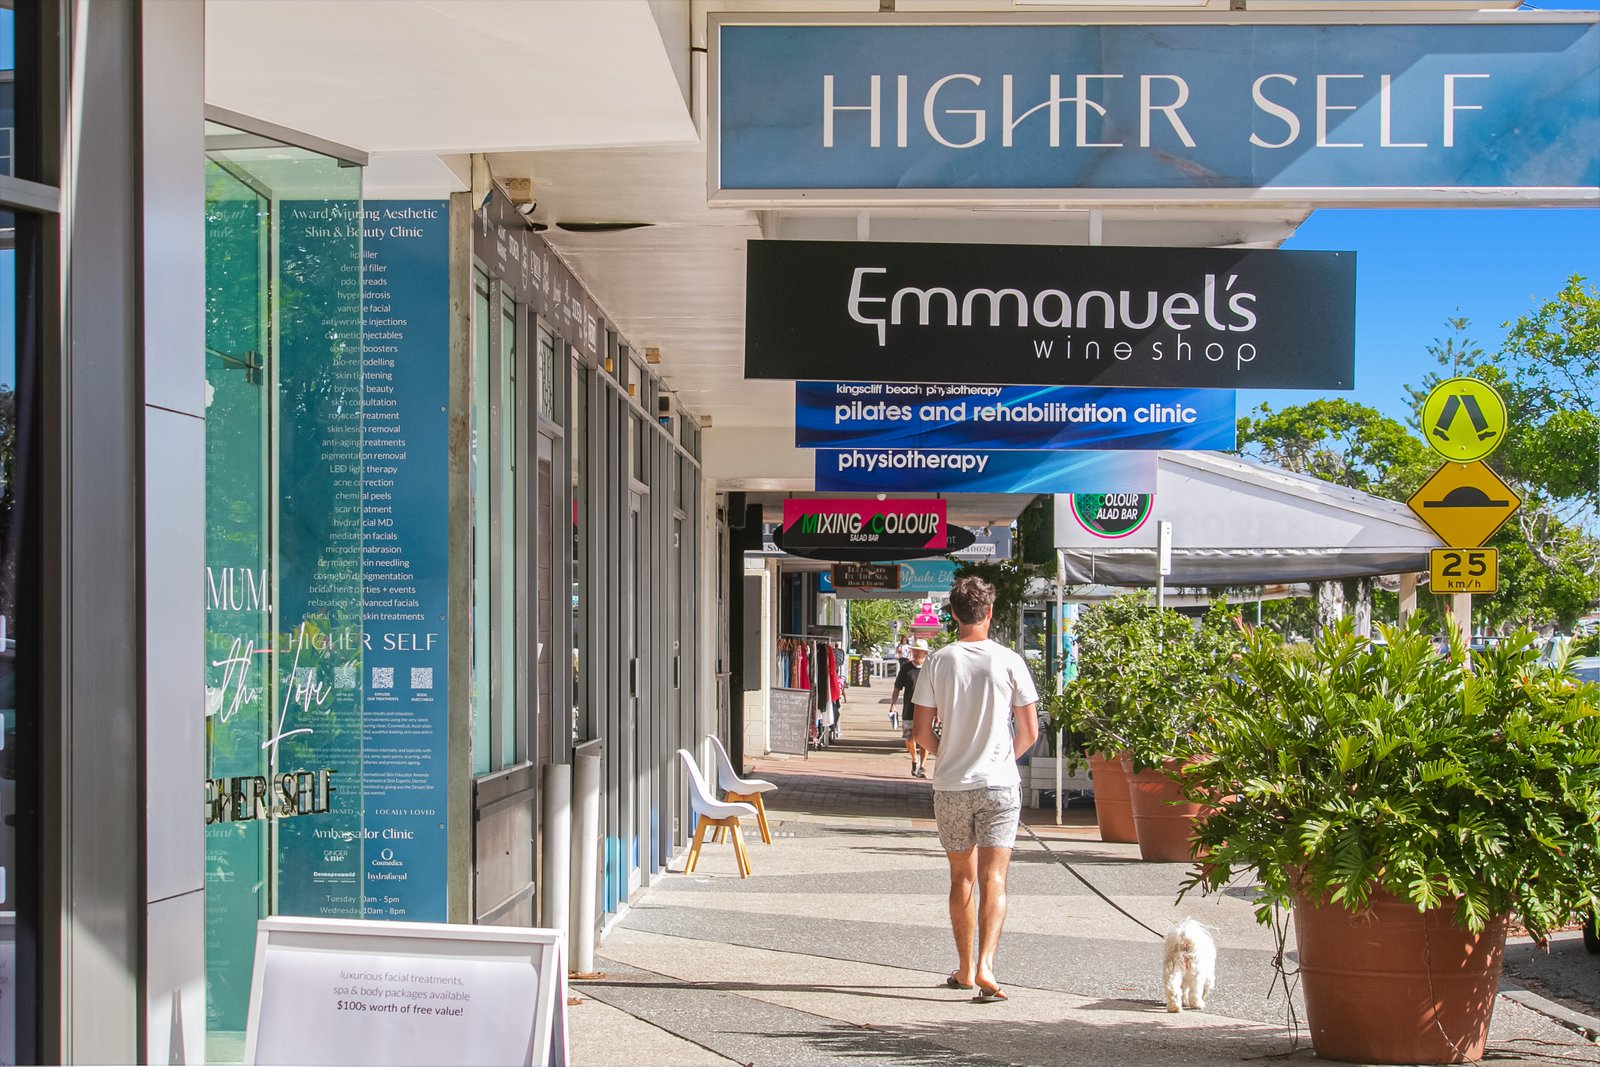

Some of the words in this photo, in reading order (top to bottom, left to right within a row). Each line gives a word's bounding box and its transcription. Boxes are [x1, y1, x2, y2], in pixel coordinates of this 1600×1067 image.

[822, 73, 1197, 149] HIGHER
[1250, 73, 1491, 149] SELF
[291, 208, 328, 219] Award
[383, 208, 438, 219] Aesthetic
[305, 226, 331, 237] Skin
[333, 227, 343, 237] &
[347, 226, 386, 240] Beauty
[390, 226, 423, 237] Clinic
[360, 251, 378, 259] iller
[369, 264, 387, 272] filler
[341, 278, 356, 286] pdo
[359, 277, 387, 286] hreads
[337, 304, 368, 314] vampe
[370, 304, 391, 313] facial
[847, 266, 1257, 346] Emmanuel's
[321, 318, 367, 327] anti-wrinke
[369, 318, 407, 327] injections
[361, 331, 403, 340] njectables
[363, 345, 398, 353] boosters
[1033, 335, 1133, 361] wine
[1152, 333, 1257, 371] shop
[335, 371, 352, 379] skin
[334, 385, 359, 393] brows
[366, 385, 394, 394] beauty
[836, 384, 882, 397] kingscliff
[885, 385, 923, 395] beach
[926, 384, 1002, 398] physiotherapy
[331, 398, 348, 406] skin
[361, 412, 399, 420] reatment
[835, 401, 912, 425] pilates
[919, 403, 966, 422] and
[973, 402, 1126, 423] rehabilitation
[1133, 403, 1197, 424] clinic
[327, 425, 343, 433] skin
[368, 425, 401, 433] removal
[321, 452, 373, 461] pigmentaton
[374, 452, 406, 460] removal
[838, 450, 989, 473] physiotherapy
[330, 465, 347, 473] LED
[367, 465, 398, 474] therapy
[336, 492, 369, 500] chemial
[371, 492, 391, 501] peels
[1098, 494, 1139, 507] COLOUR
[335, 506, 351, 514] scar
[353, 506, 392, 514] tratment
[1092, 508, 1119, 520] SALAD
[1120, 508, 1139, 520] BAR
[333, 518, 376, 528] hydrafcial
[378, 518, 394, 527] MD
[802, 512, 862, 534] MIXING
[871, 512, 939, 534] COLOUR
[330, 532, 371, 540] meditaton
[372, 532, 398, 540] facials
[850, 533, 868, 541] SALAD
[868, 533, 880, 541] BAR
[360, 559, 374, 567] kin
[376, 559, 410, 568] needling
[1442, 553, 1487, 577] 25
[1448, 579, 1481, 589] km/h
[355, 585, 380, 595] prties
[389, 586, 416, 594] events
[394, 598, 419, 607] facials
[363, 612, 379, 620] skin
[380, 612, 424, 620] treatments
[289, 633, 372, 651] HIGHER
[384, 633, 438, 651] SELF
[375, 808, 407, 816] LOCALLY
[411, 808, 435, 816] LOVED
[382, 828, 414, 840] Clinic
[367, 871, 408, 882] hydrafacial
[326, 894, 357, 904] Tuesday
[384, 895, 400, 905] 5pm
[363, 907, 384, 915] 10am
[389, 906, 406, 917] 8pm
[340, 970, 383, 981] luxurious
[385, 971, 409, 982] facial
[410, 974, 465, 986] treatments,
[333, 986, 349, 997] spa
[350, 985, 359, 995] &
[360, 985, 383, 998] body
[385, 988, 428, 1001] packages
[429, 990, 470, 1002] available
[337, 1000, 367, 1011] $100s
[369, 1002, 398, 1013] worth
[400, 1003, 411, 1013] of
[413, 1004, 433, 1015] free
[434, 1006, 464, 1017] value!
